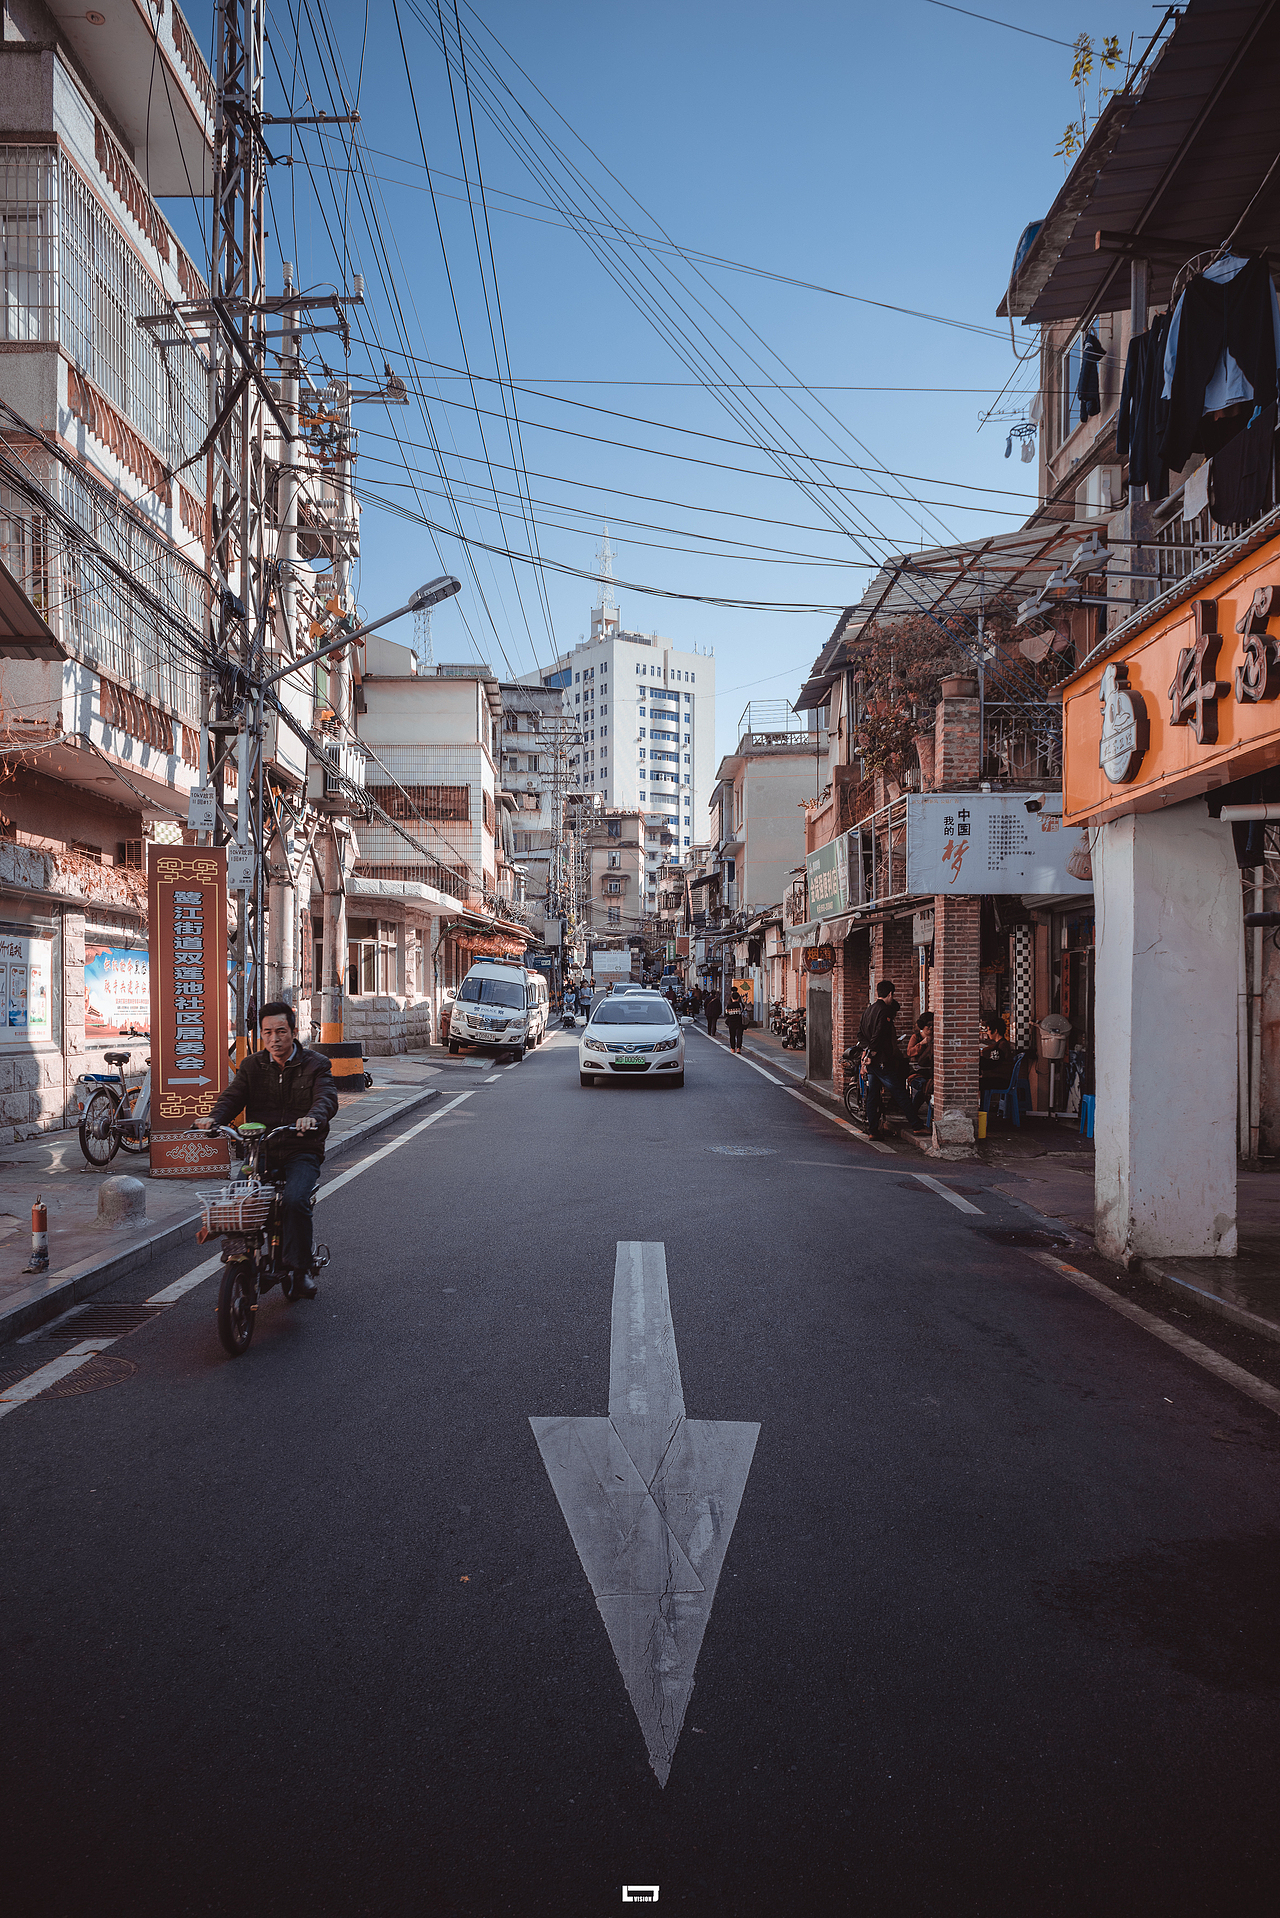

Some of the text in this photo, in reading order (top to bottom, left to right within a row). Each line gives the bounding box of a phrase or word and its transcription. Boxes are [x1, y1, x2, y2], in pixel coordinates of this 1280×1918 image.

[943, 816, 955, 836] 我的
[957, 808, 971, 836] 中国
[941, 839, 970, 884] 梦
[807, 947, 832, 960] 烟酒
[810, 960, 831, 970] 复印
[172, 890, 206, 1071] 鹭江街道双莲池社区居委会
